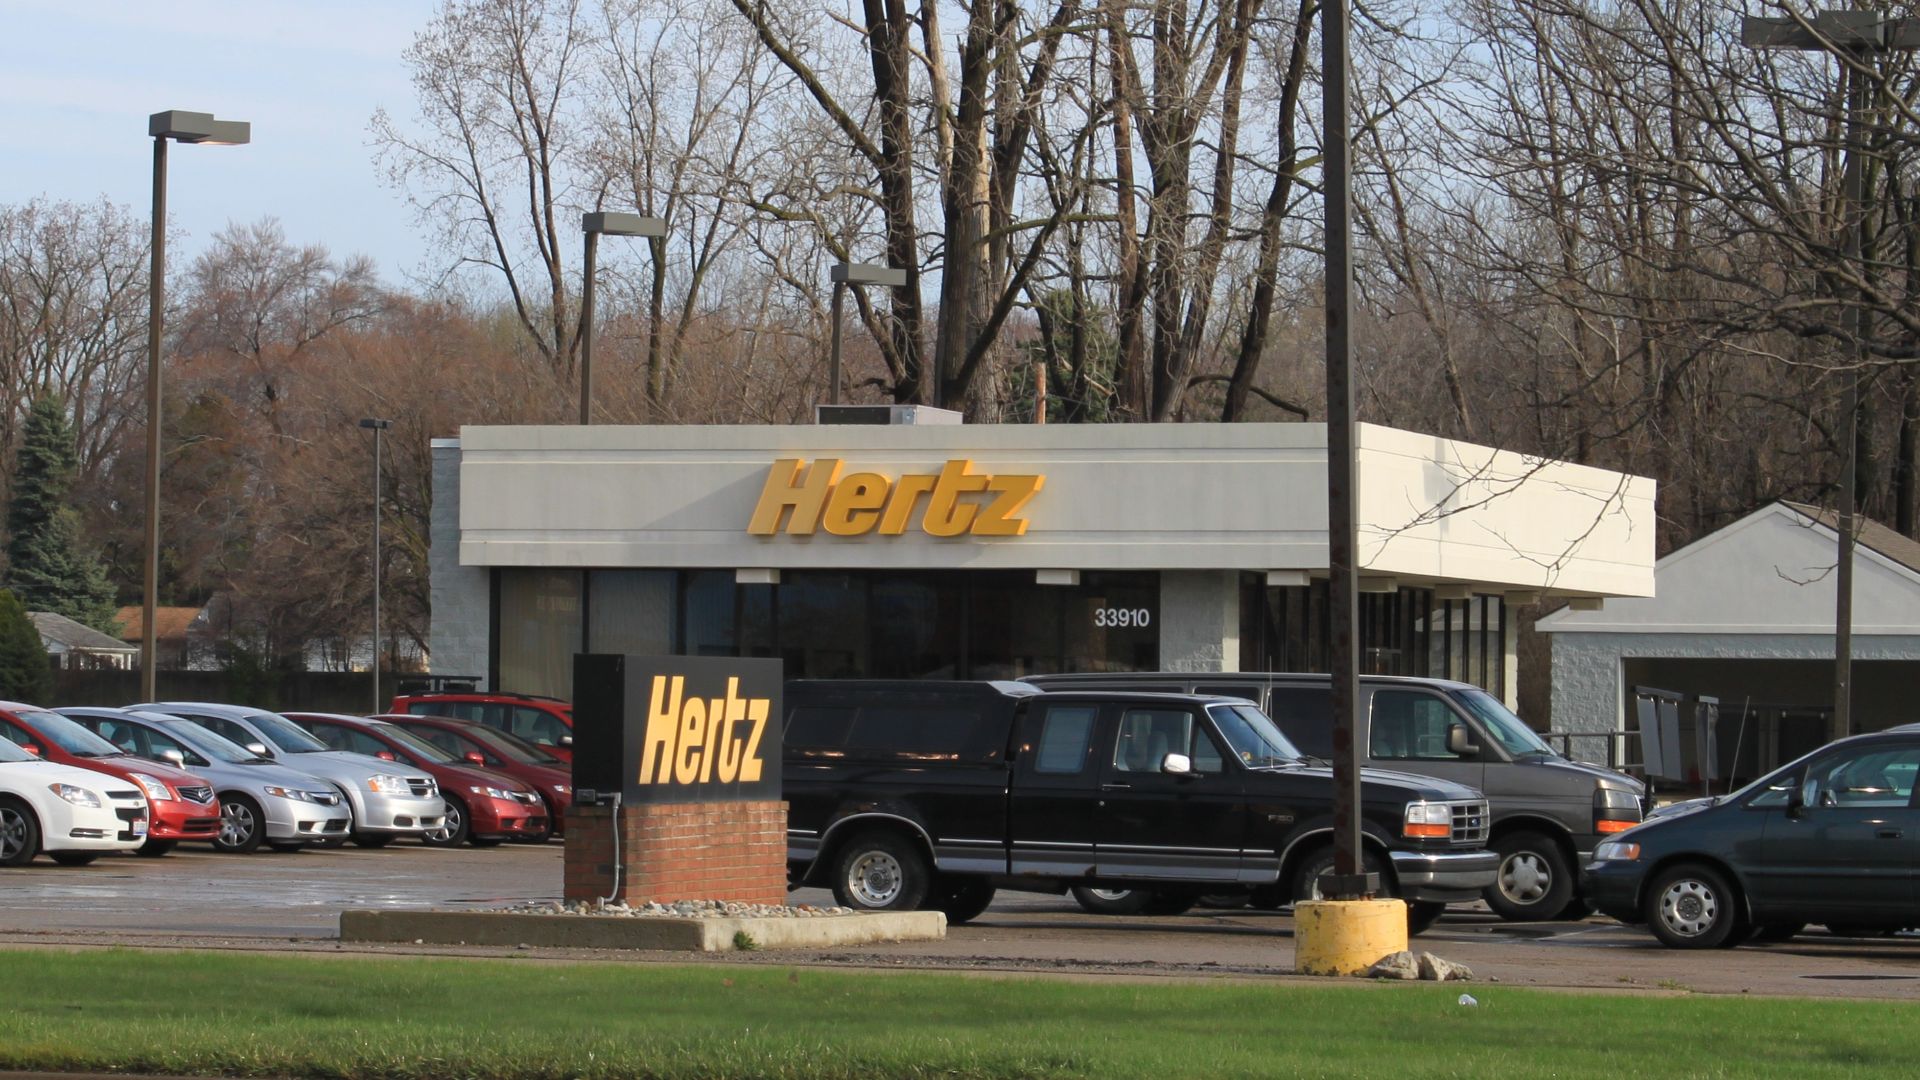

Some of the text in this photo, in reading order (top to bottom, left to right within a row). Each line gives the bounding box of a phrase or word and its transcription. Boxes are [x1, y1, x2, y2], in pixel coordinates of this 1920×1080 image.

[747, 458, 1046, 537] Hertz
[1094, 608, 1150, 627] 33910
[638, 675, 770, 785] Hertz
